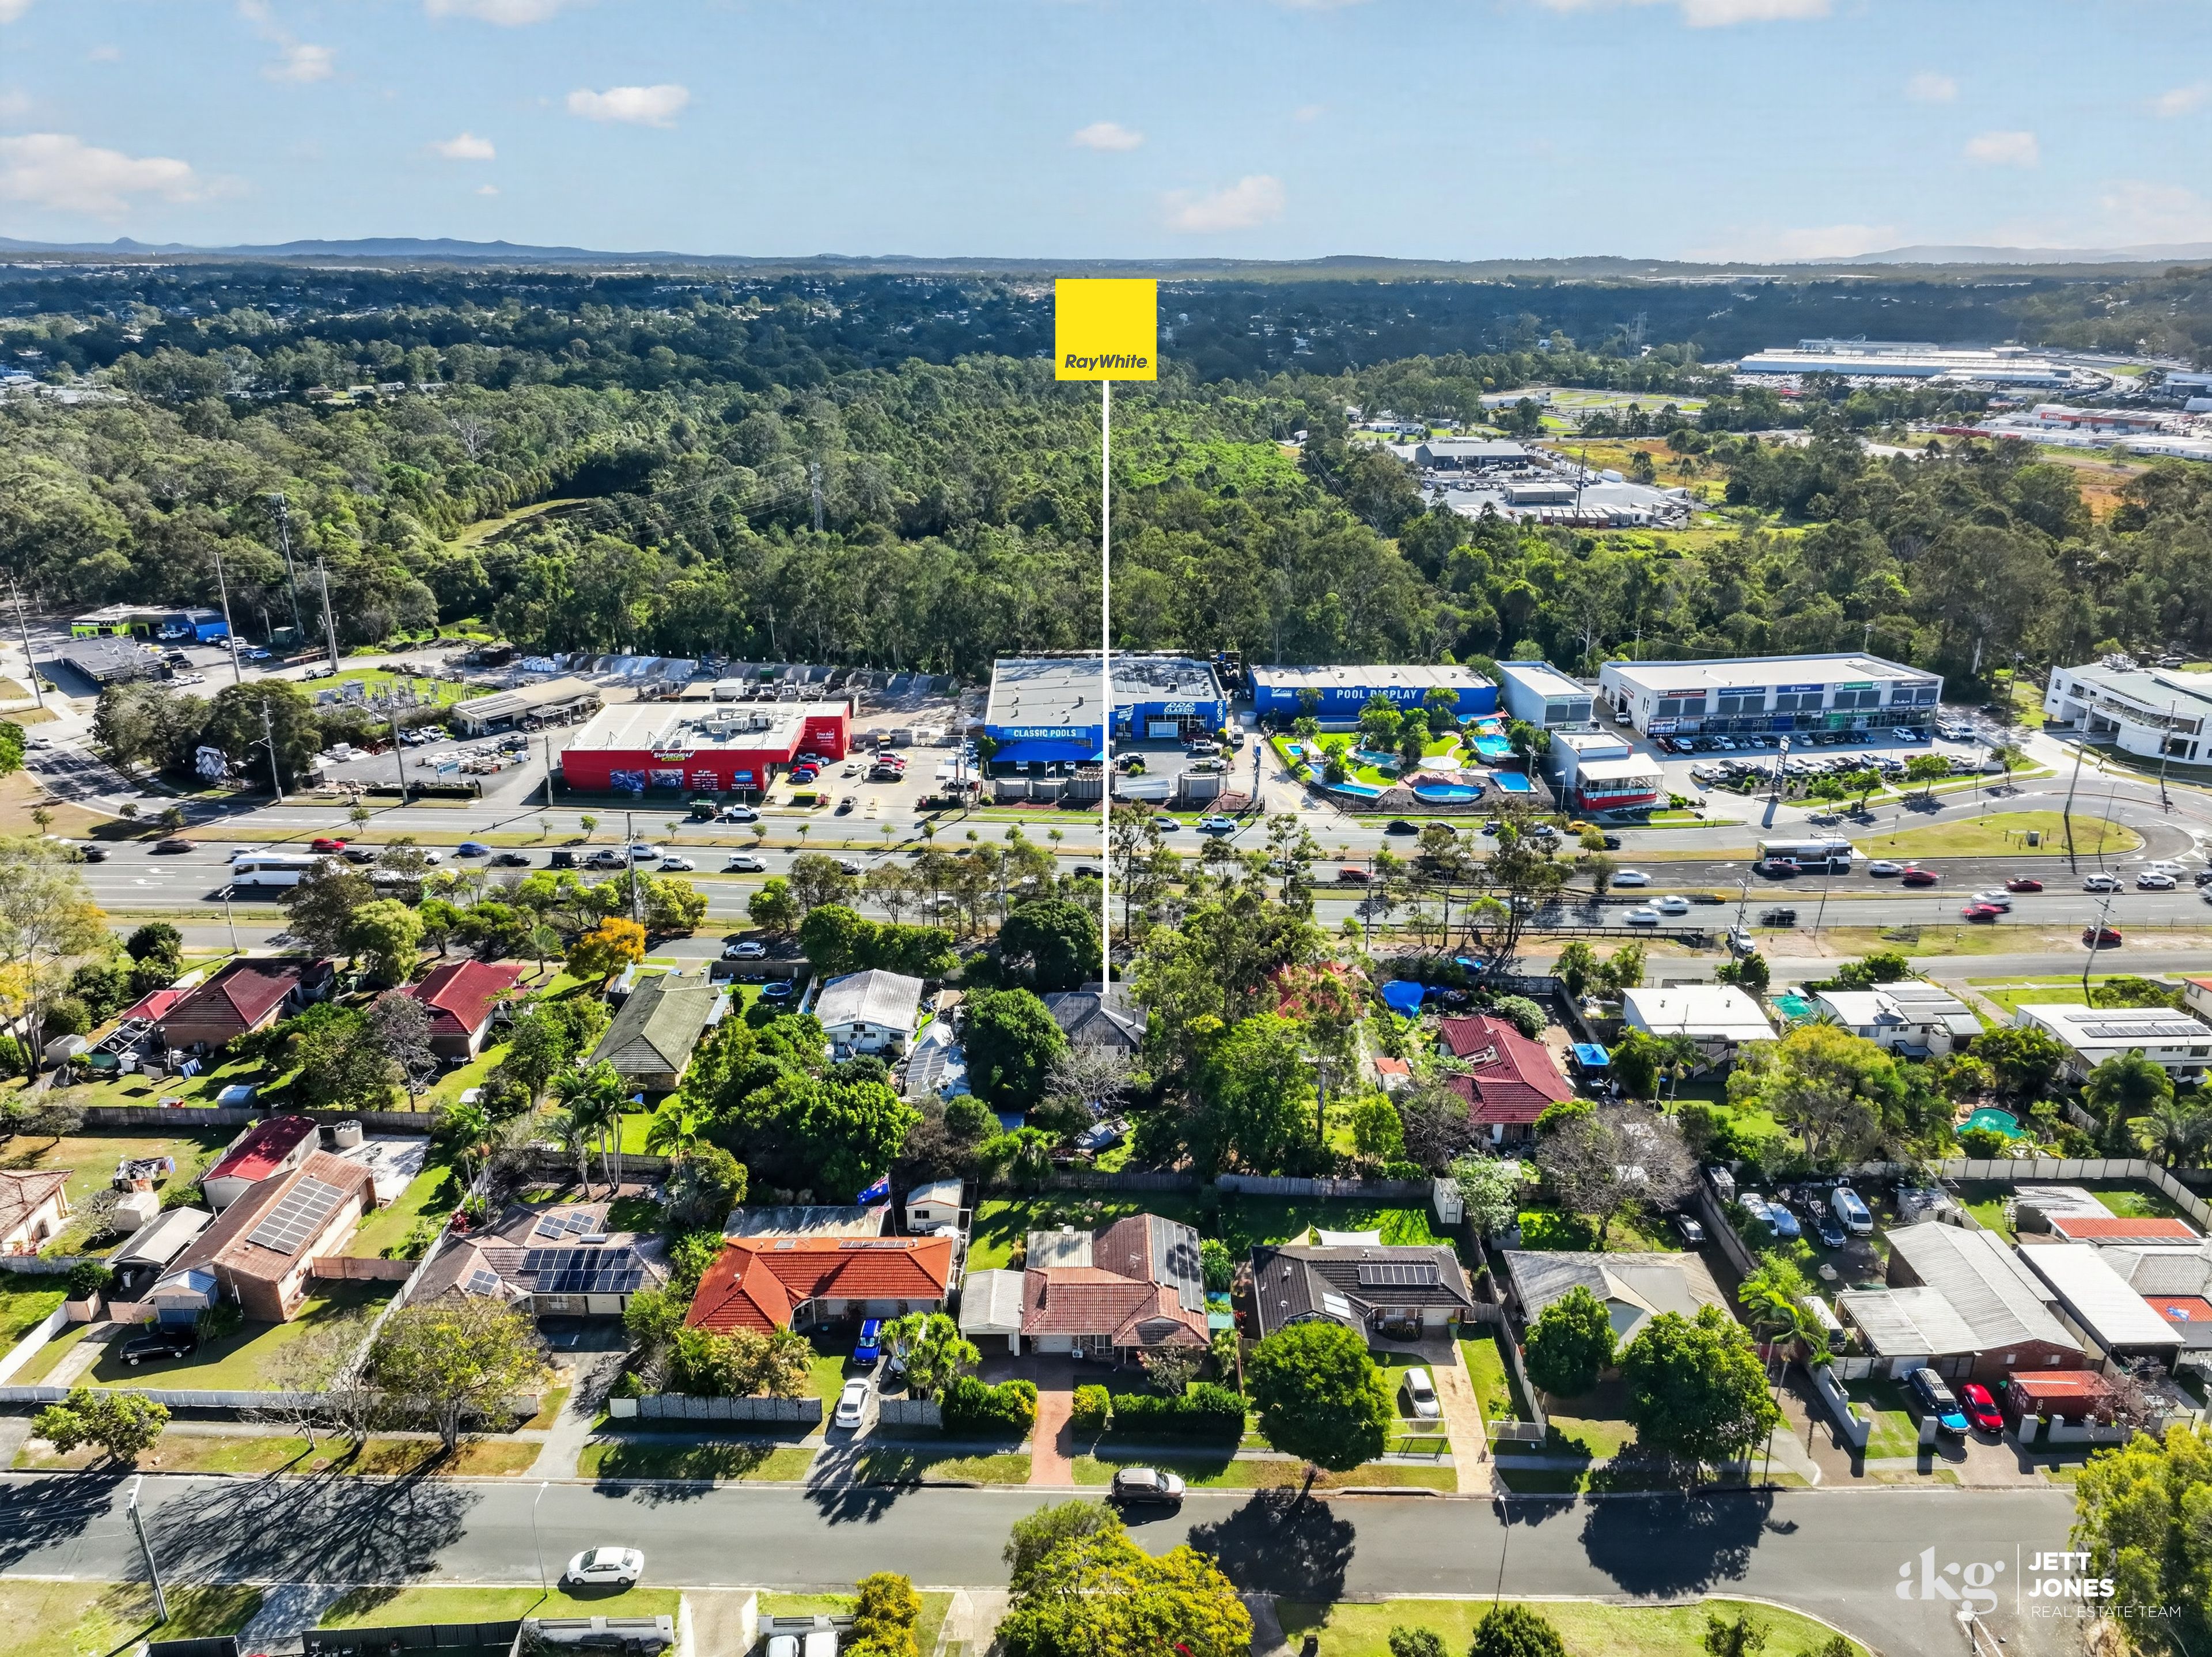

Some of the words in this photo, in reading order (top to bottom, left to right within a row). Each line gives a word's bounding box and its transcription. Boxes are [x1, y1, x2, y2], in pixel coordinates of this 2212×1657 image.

[1336, 689, 1365, 699] POOL
[1013, 729, 1048, 737] CLASSIC
[1050, 729, 1077, 737] POOLS
